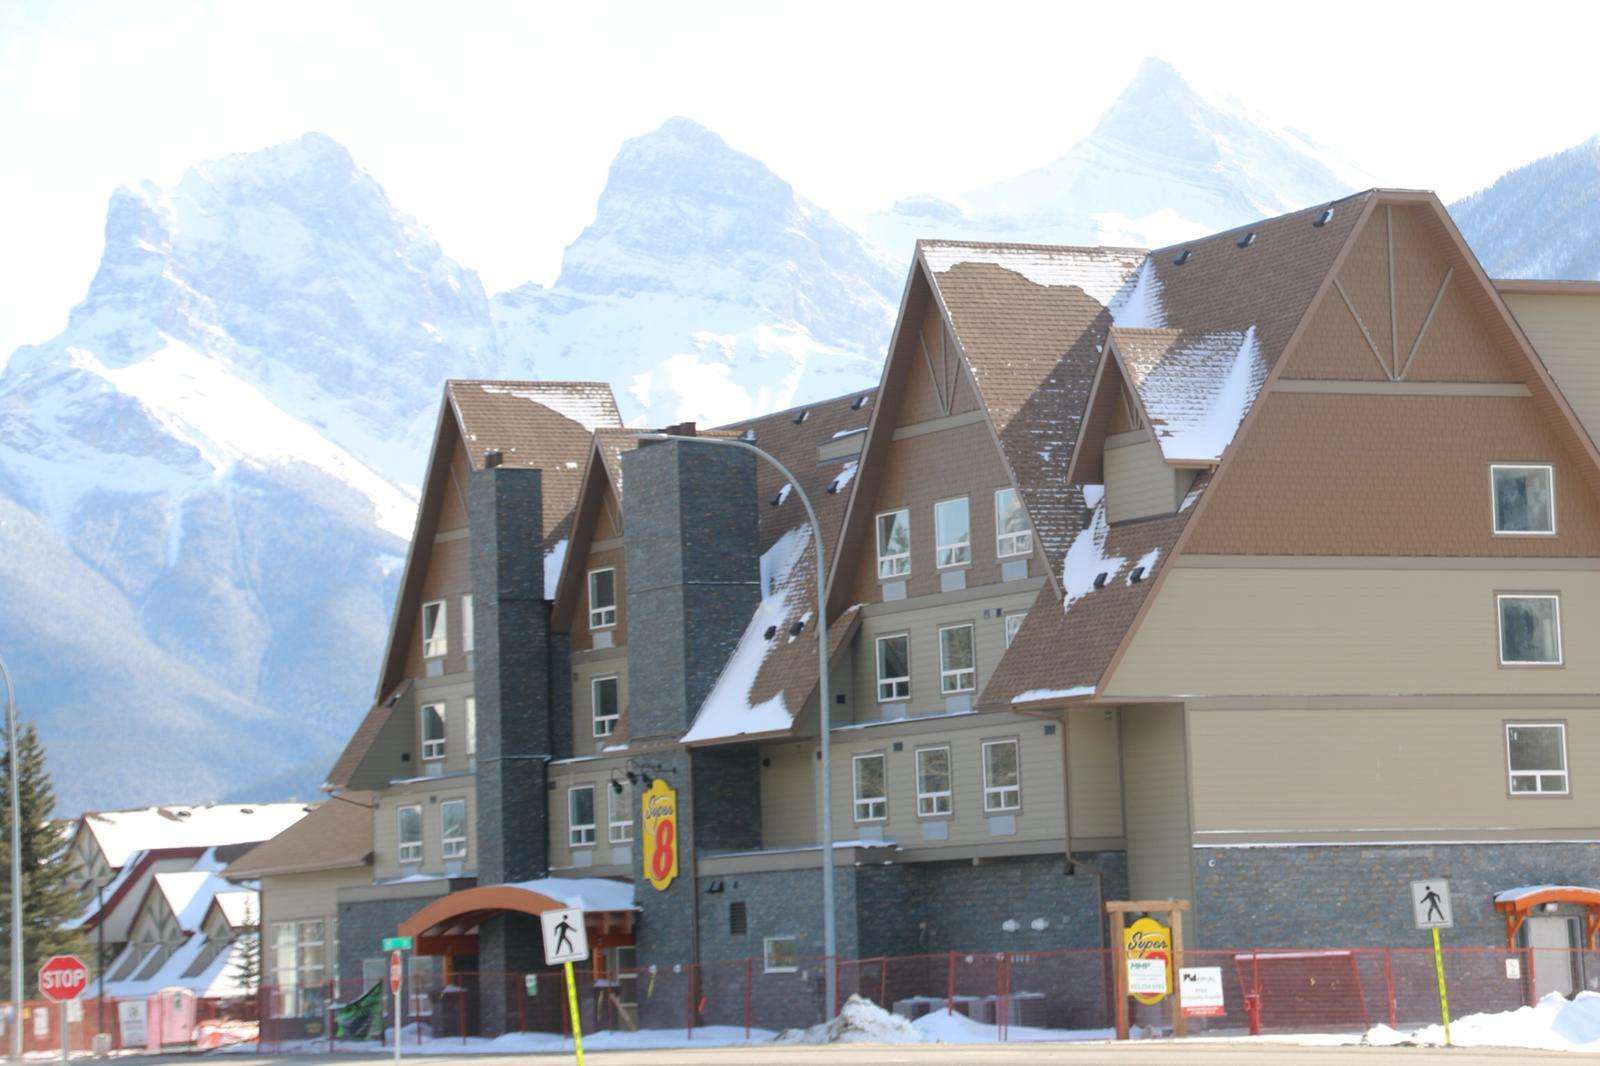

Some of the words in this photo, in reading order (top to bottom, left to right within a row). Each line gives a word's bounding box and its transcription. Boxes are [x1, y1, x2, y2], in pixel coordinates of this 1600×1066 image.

[646, 795, 673, 825] Super
[653, 819, 674, 881] 8
[1128, 931, 1168, 958] Super
[44, 969, 84, 989] STOP
